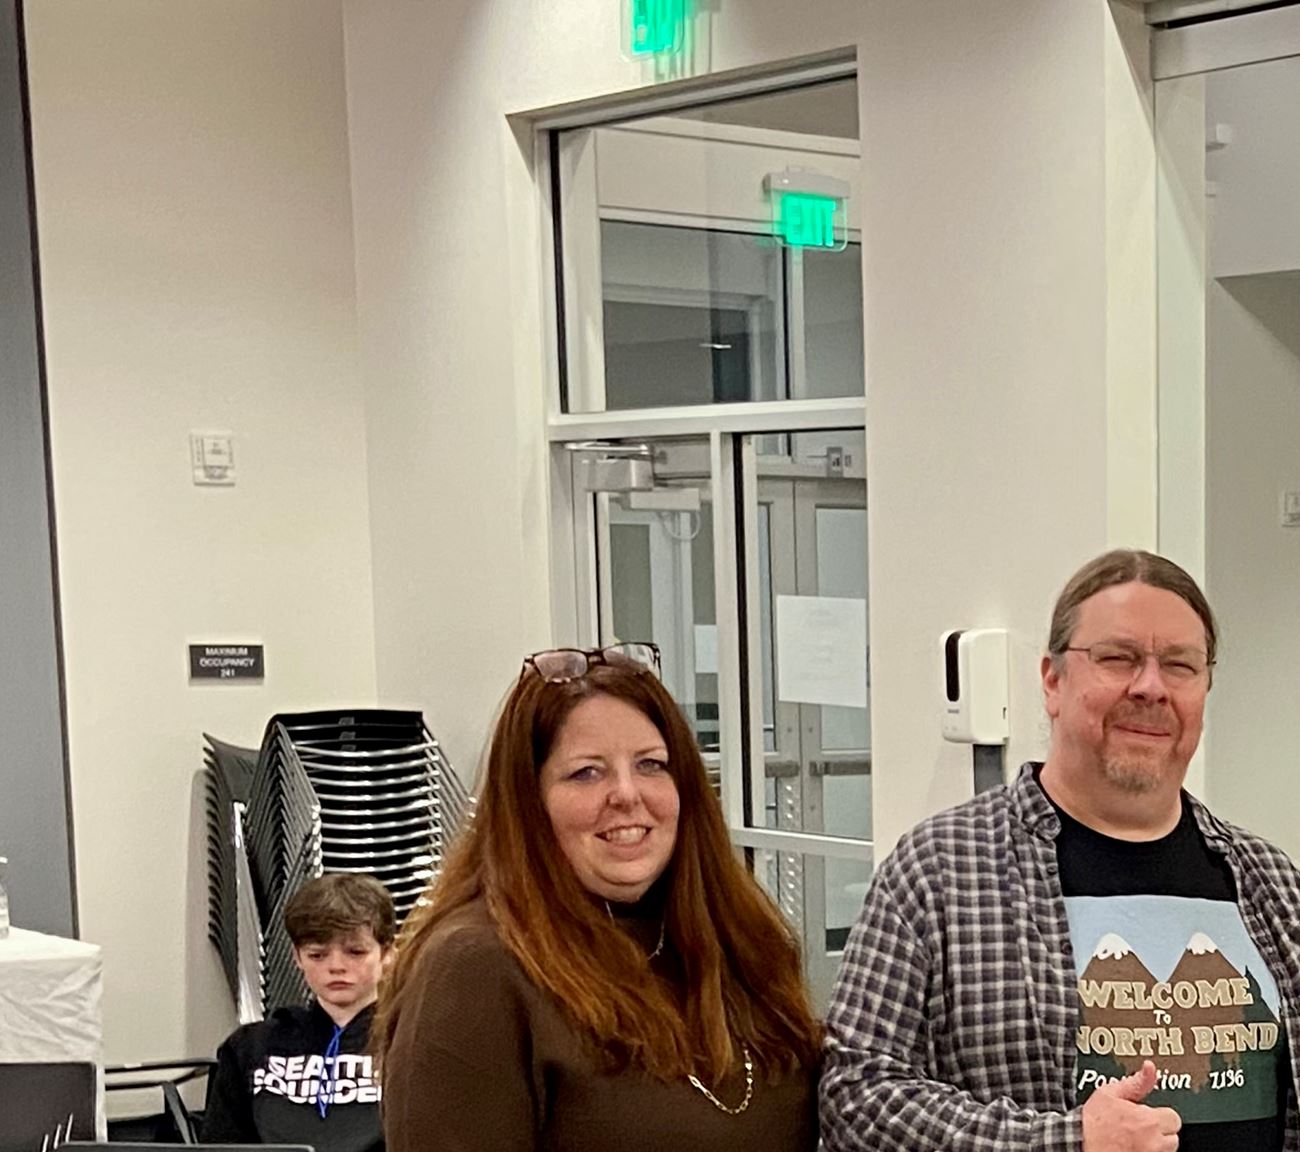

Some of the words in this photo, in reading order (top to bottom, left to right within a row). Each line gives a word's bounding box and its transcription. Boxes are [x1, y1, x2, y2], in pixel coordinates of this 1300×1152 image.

[785, 195, 836, 247] EXIT
[199, 657, 255, 668] OCCUPANCY
[205, 647, 248, 656] MAXIMUM
[220, 668, 235, 678] 241
[1078, 976, 1255, 1010] WELCOME
[1153, 1010, 1172, 1025] To
[1076, 1025, 1185, 1056] NORTH
[1190, 1022, 1279, 1054] BEND
[268, 1054, 373, 1081] SEATTL
[253, 1068, 382, 1105] SOUNDE
